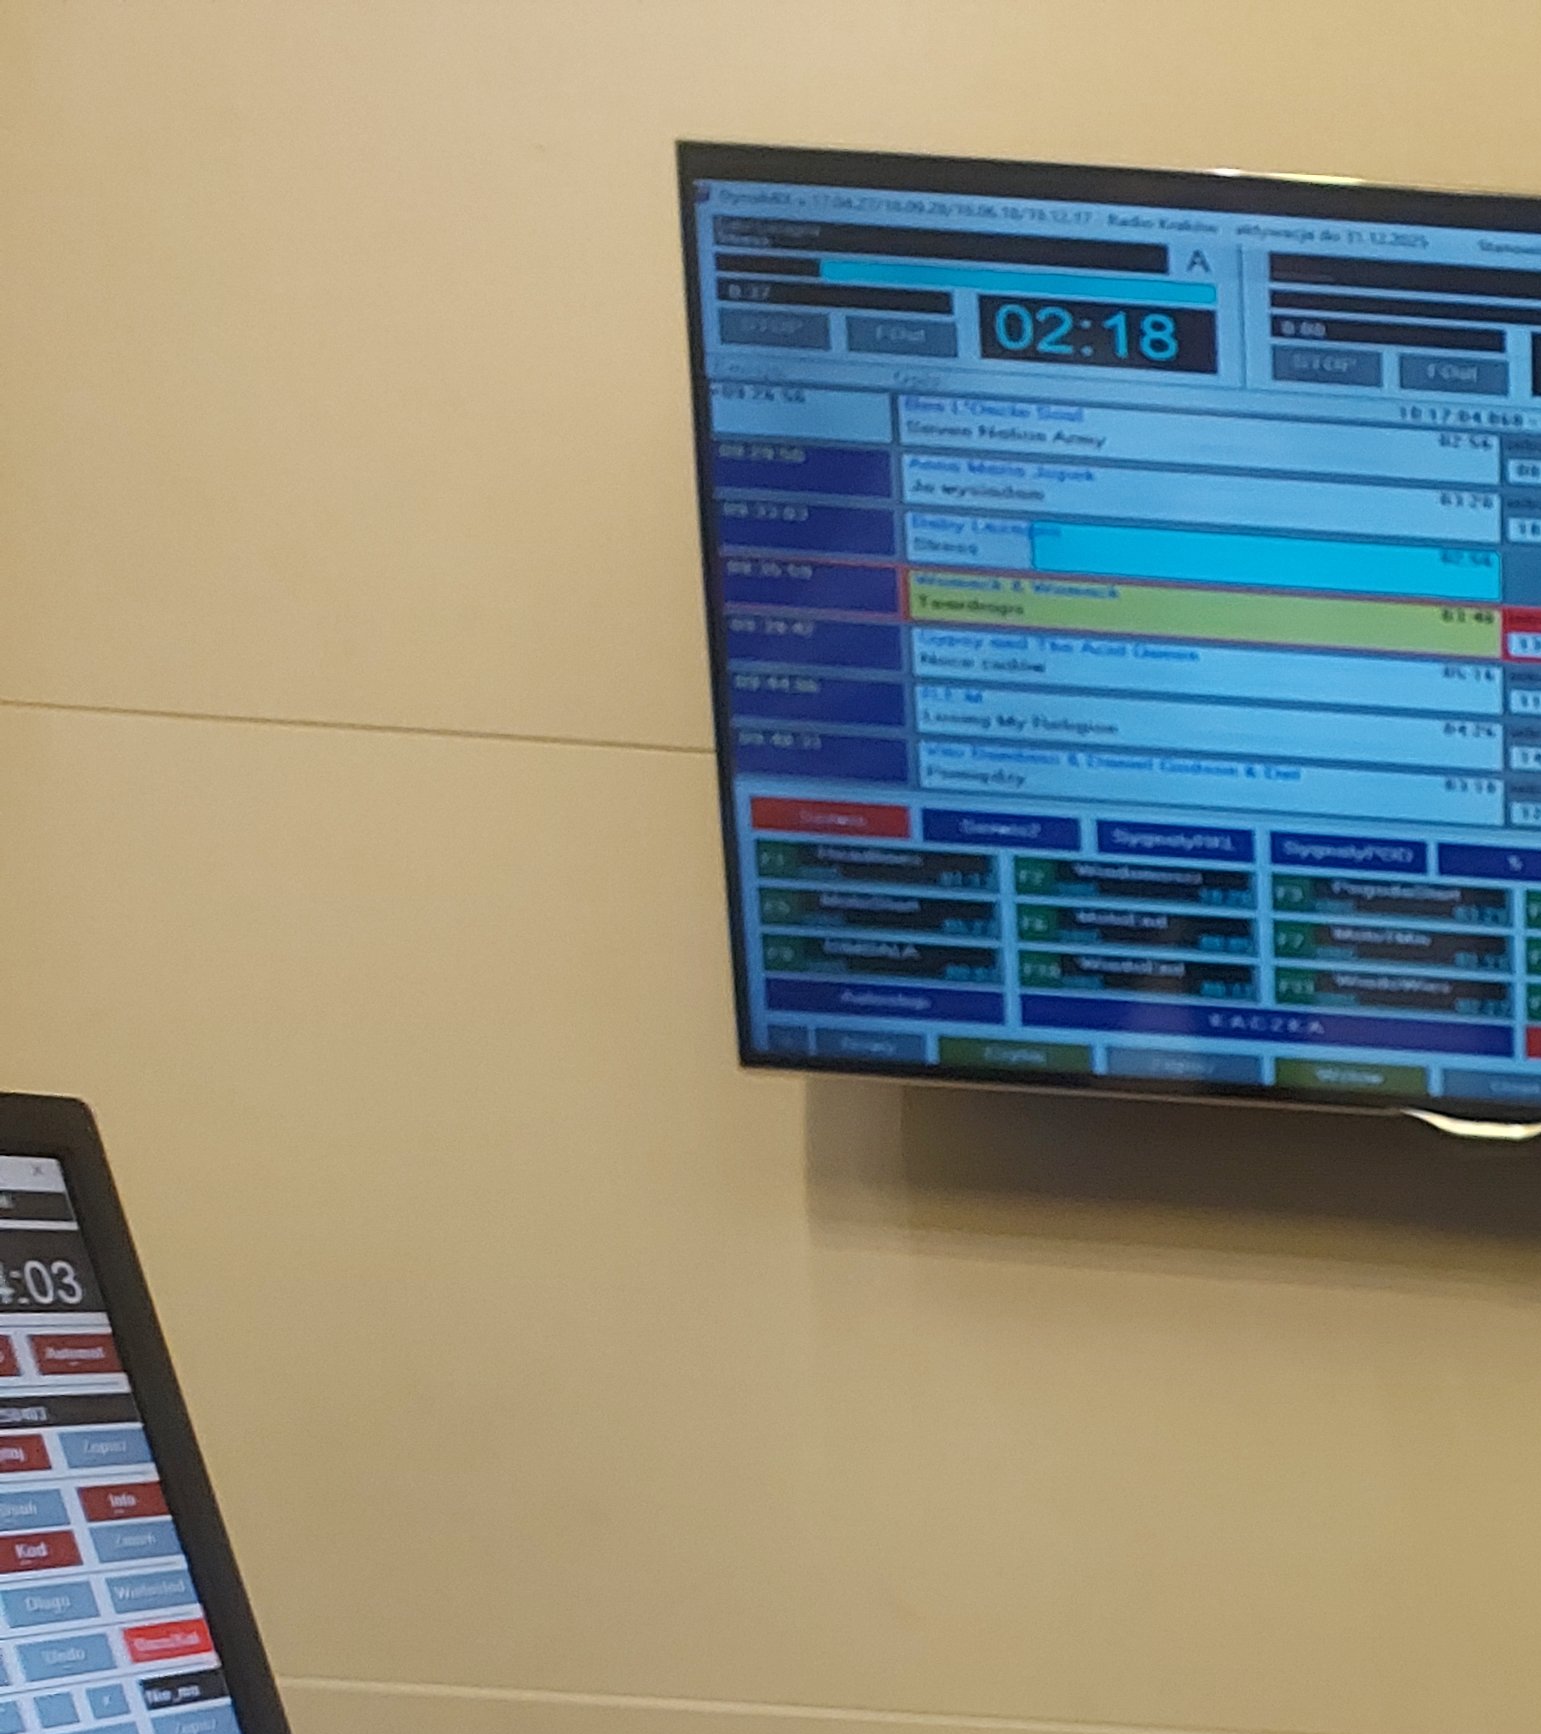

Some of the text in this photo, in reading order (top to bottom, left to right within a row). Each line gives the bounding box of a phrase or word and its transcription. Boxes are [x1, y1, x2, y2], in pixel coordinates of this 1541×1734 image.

[1185, 248, 1212, 276] A
[994, 301, 1179, 364] 02:18
[15, 1541, 49, 1560] Kod
